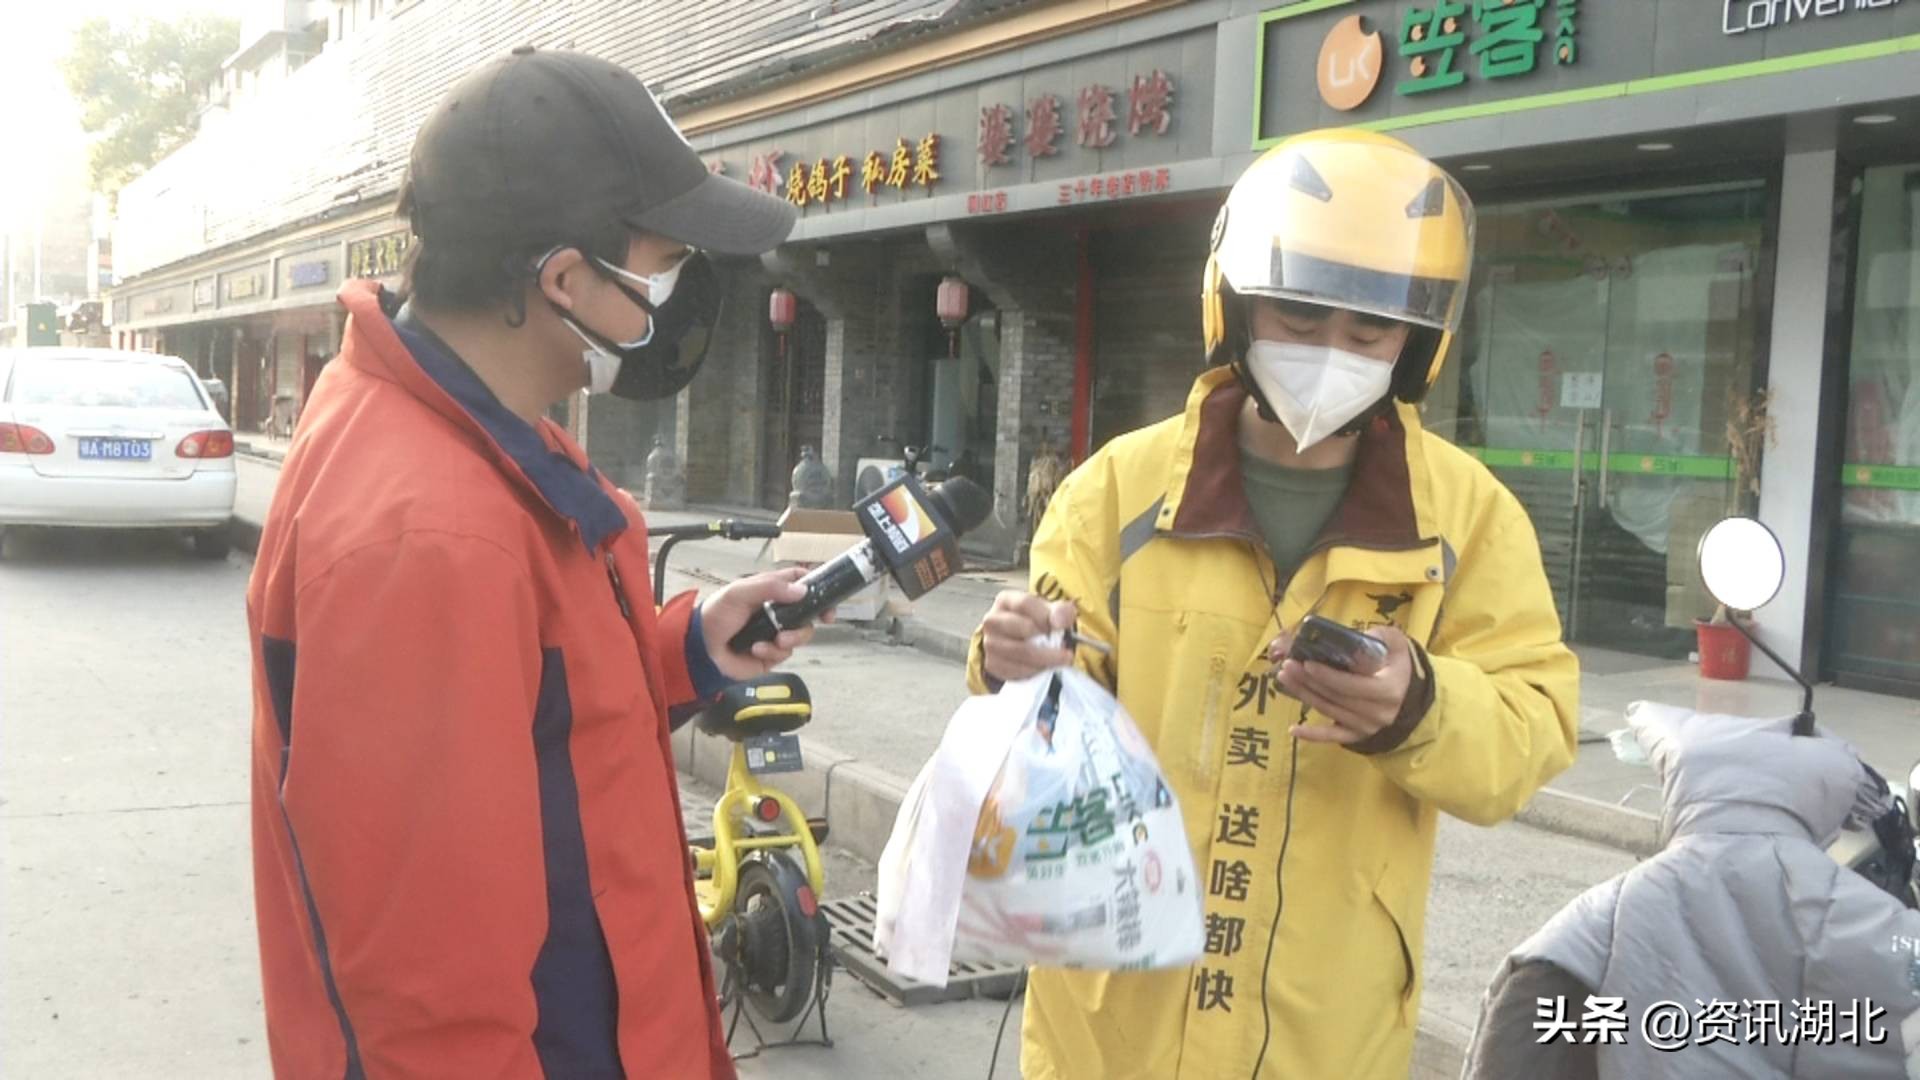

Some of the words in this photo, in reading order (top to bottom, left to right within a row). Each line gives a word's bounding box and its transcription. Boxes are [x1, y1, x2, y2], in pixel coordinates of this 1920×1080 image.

[861, 132, 940, 194] 私房菜
[1194, 803, 1260, 1014] 送啥都快
